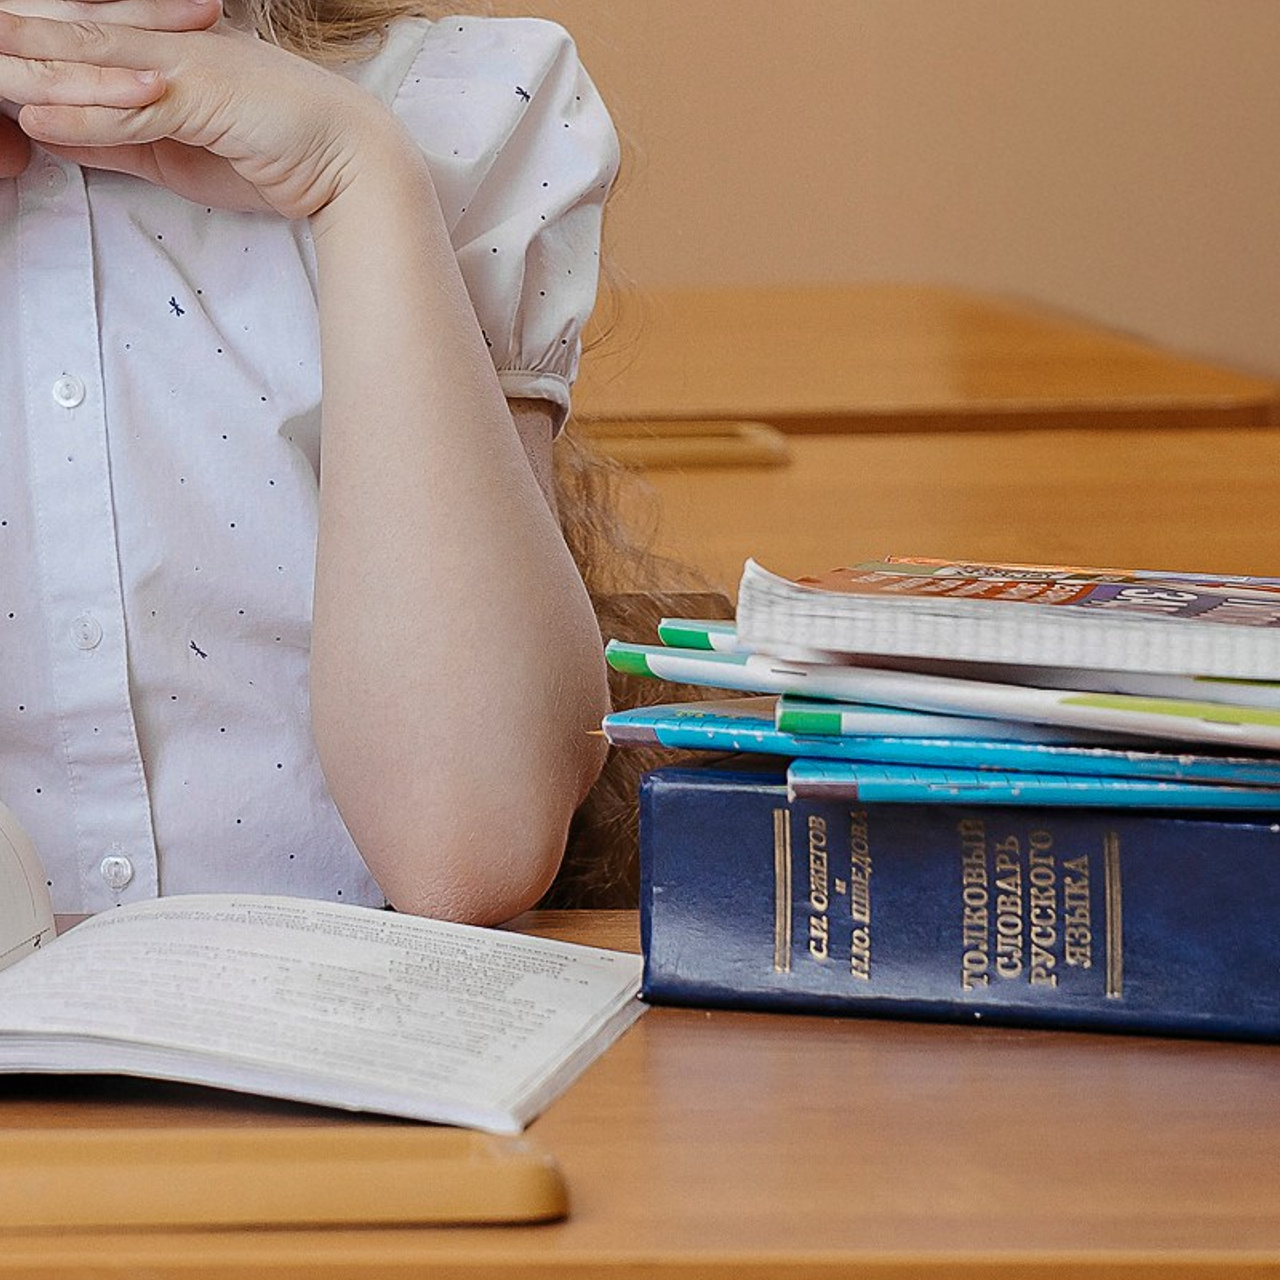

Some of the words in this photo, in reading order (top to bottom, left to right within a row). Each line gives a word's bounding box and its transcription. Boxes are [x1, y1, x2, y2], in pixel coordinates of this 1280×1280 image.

[808, 815, 829, 912] ОЖЕГОВ
[957, 819, 989, 991] ТОЛКОВЫЙ
[996, 834, 1023, 979] СЛОВАРЬ
[1029, 829, 1057, 989] РУССКОГО
[1063, 854, 1093, 969] ЯЗЫКА
